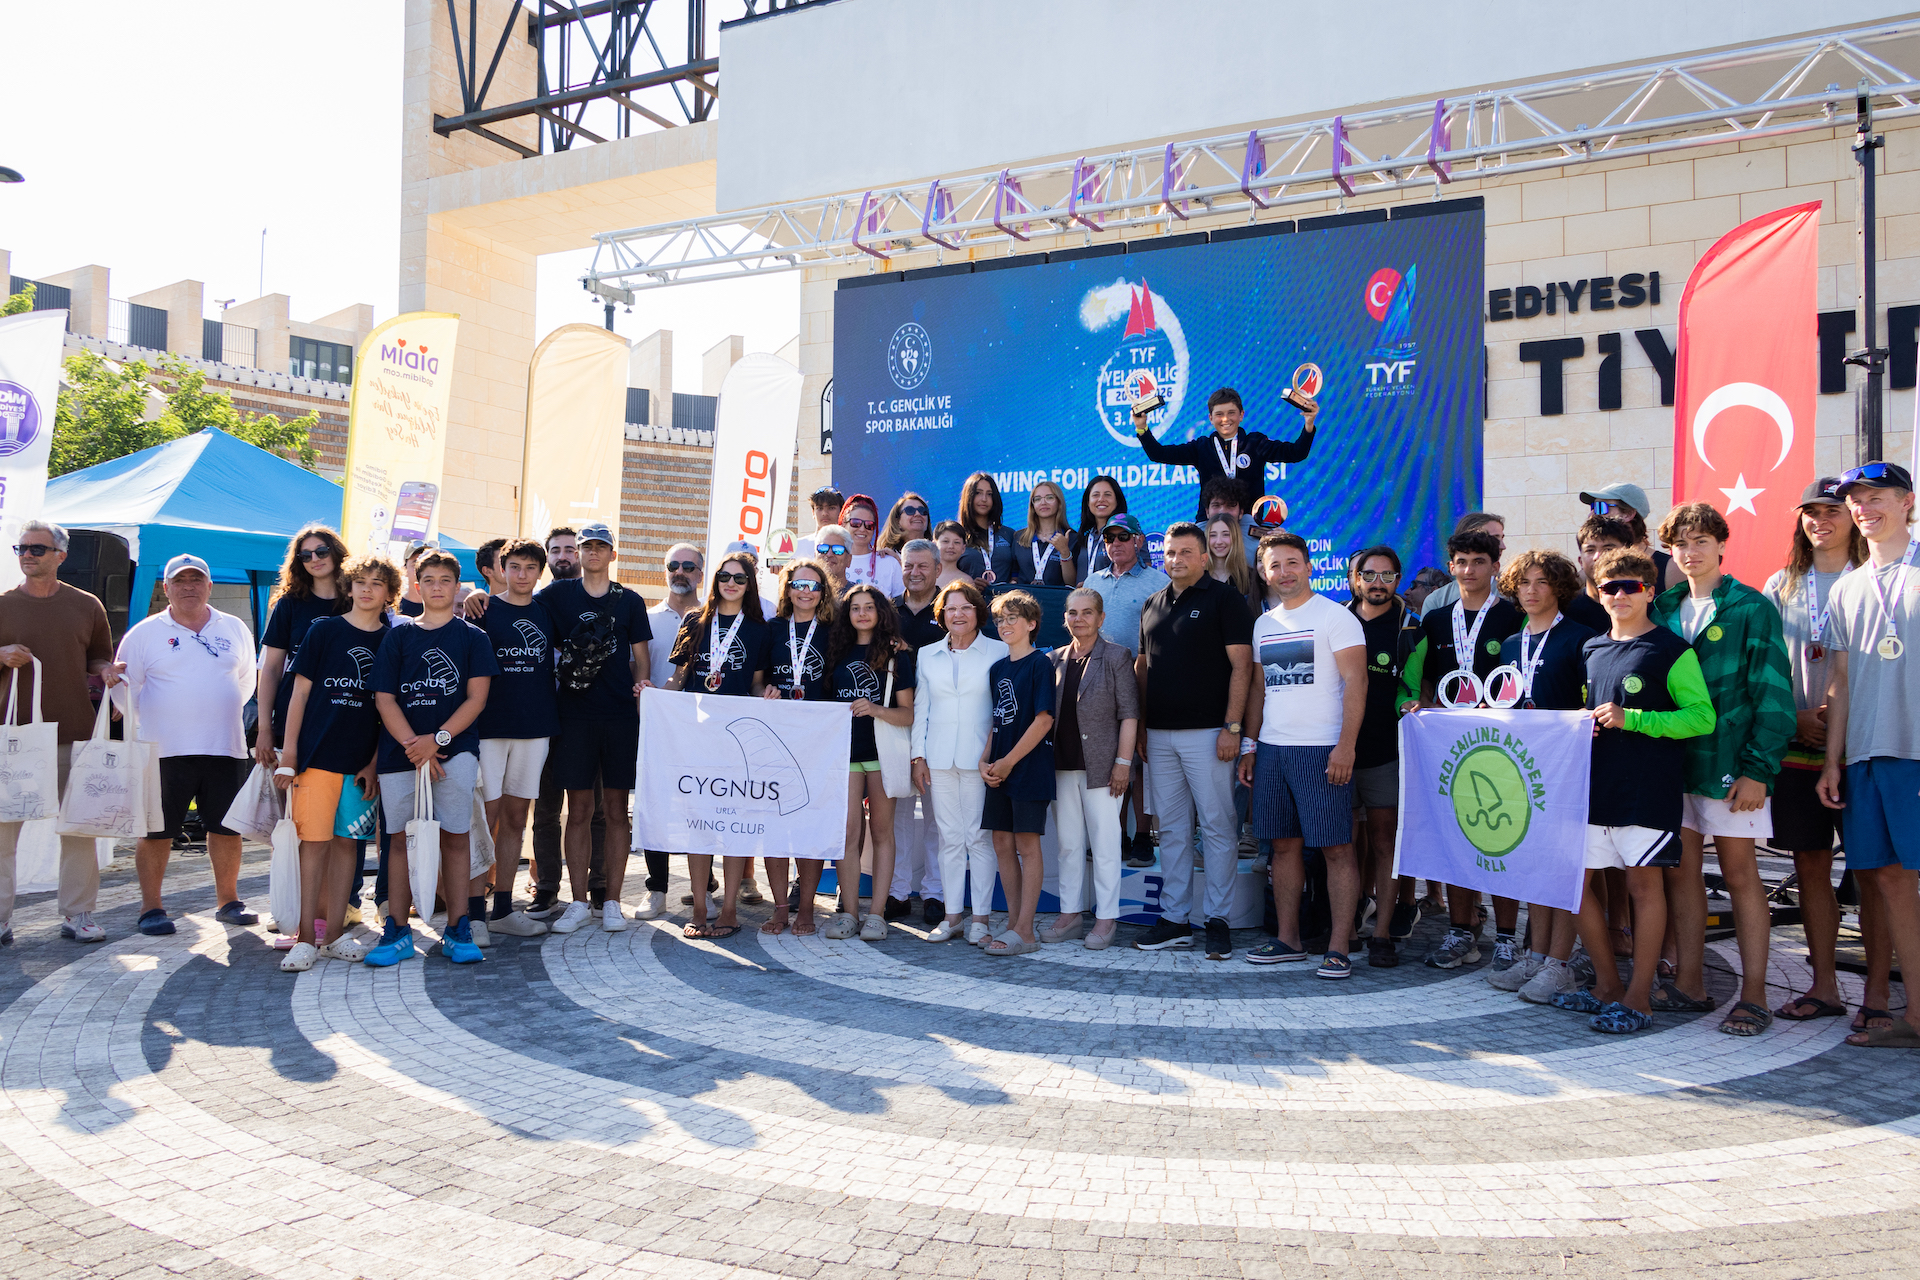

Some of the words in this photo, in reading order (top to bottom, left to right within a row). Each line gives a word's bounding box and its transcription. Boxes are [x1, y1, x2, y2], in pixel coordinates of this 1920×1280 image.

[1488, 270, 1661, 322] EDİYESİ
[1129, 346, 1156, 364] TYF
[1365, 360, 1416, 385] TYF
[0, 389, 27, 405] DİM
[868, 401, 876, 415] T.
[878, 400, 888, 414] C.
[890, 394, 936, 415] GENÇLİK
[937, 395, 951, 409] VE
[865, 419, 893, 434] SPOR
[895, 412, 953, 432] BAKANLIĞI
[1114, 410, 1126, 426] 3.
[993, 470, 1048, 493] WING
[738, 449, 769, 553] OTO
[1310, 555, 1344, 575] NÇLİK
[1308, 575, 1350, 591] MÜDÜR
[496, 647, 541, 658] CYGNUS
[836, 688, 871, 698] YGNUS
[1438, 759, 1455, 796] PRO
[1450, 726, 1500, 761] SAILING
[1503, 732, 1546, 812] ACADEMY
[677, 774, 780, 801] CYGNUS
[715, 806, 737, 816] URLA
[686, 818, 726, 832] WING
[730, 821, 765, 835] CLUB
[1476, 854, 1507, 872] URLA
